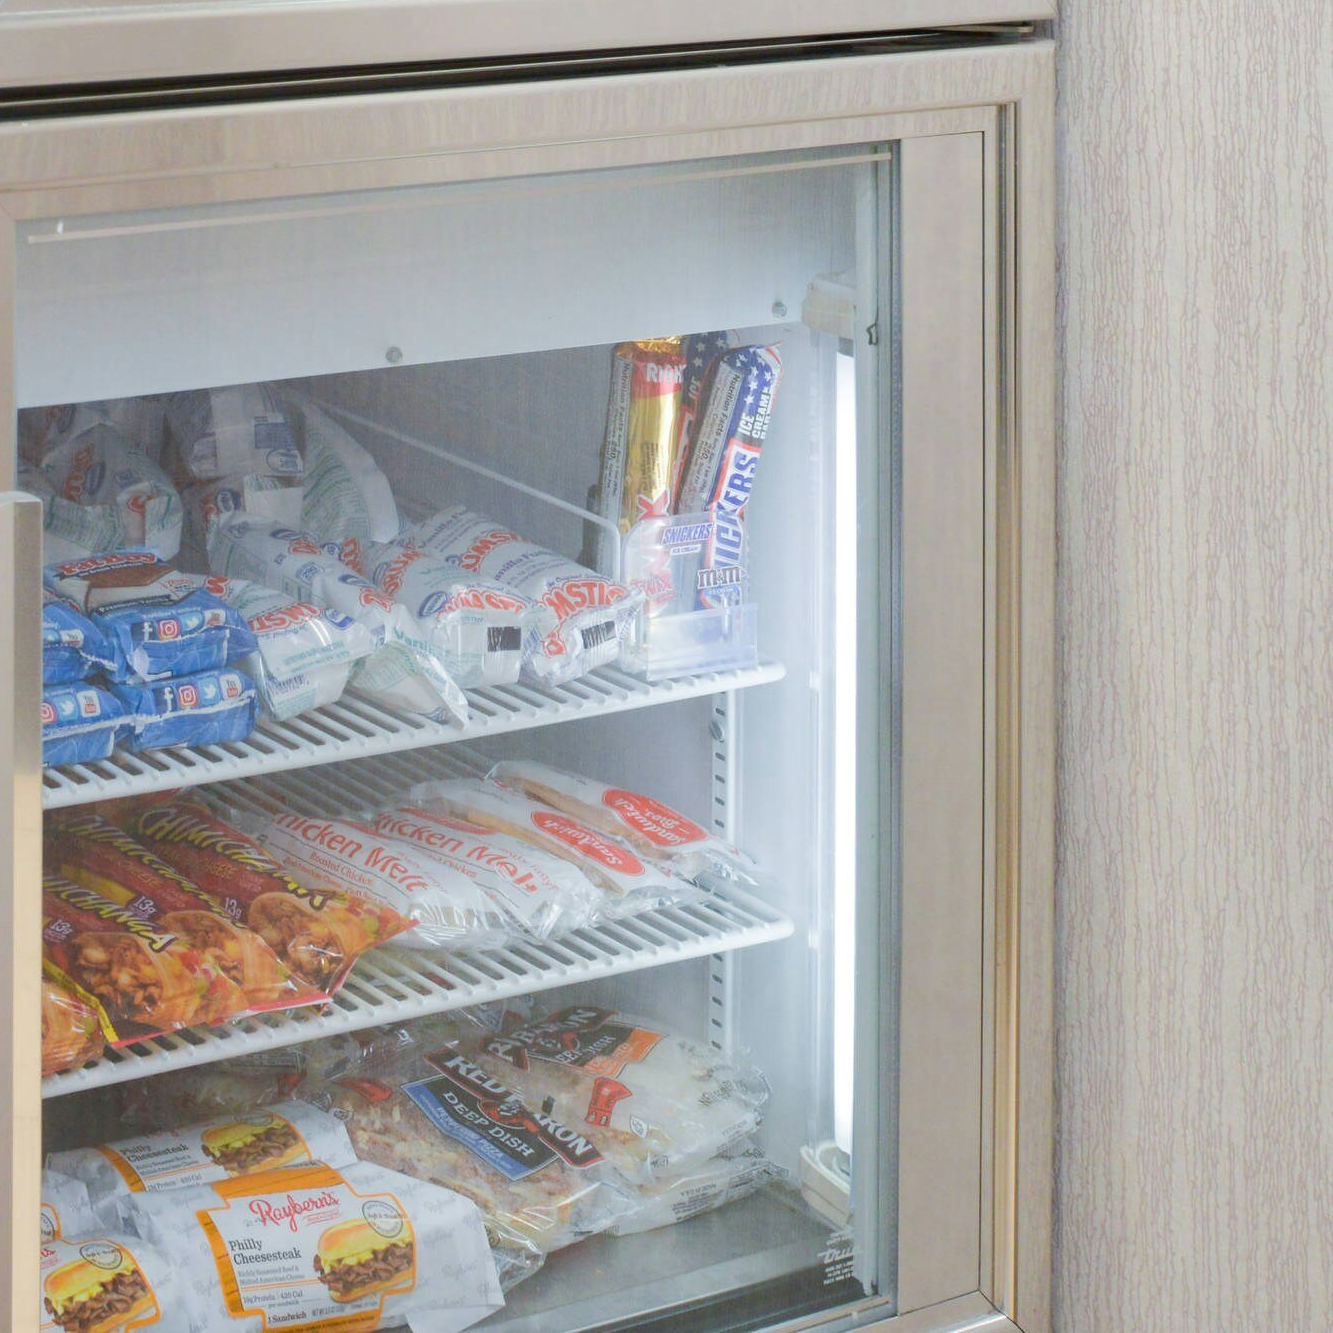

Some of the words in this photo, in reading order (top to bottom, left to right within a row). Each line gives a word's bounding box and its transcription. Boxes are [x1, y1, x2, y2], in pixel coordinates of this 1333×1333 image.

[738, 412, 755, 436] ICE
[662, 523, 712, 544] SNICKERS
[134, 895, 157, 916] 13g
[442, 1090, 490, 1126] DEEP
[488, 1126, 535, 1158] DISH
[229, 1237, 263, 1252] Philly
[233, 1247, 302, 1266] Cheesesteak
